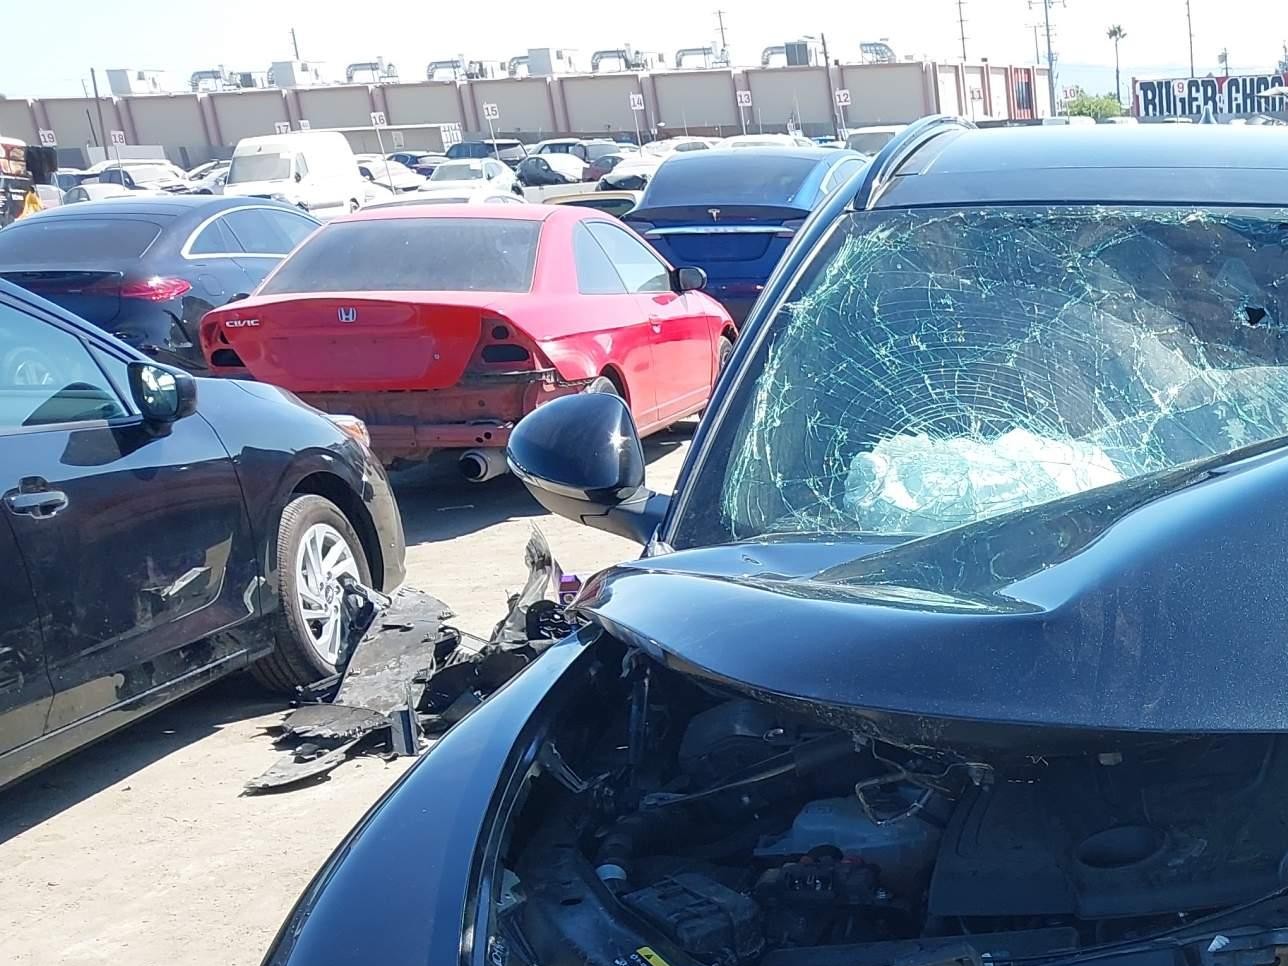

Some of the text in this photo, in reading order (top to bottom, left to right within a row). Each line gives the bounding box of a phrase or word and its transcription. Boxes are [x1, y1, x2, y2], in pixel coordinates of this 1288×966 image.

[1177, 82, 1184, 93] 9
[836, 93, 850, 103] 12
[970, 89, 983, 100] 11
[1063, 88, 1076, 98] 10
[631, 96, 644, 107] 14
[738, 93, 751, 104] 13
[485, 107, 498, 116] 15
[372, 115, 385, 124] 16
[276, 125, 289, 133] 17
[41, 133, 55, 143] 19
[112, 134, 125, 144] 18
[225, 319, 260, 328] CIVIC
